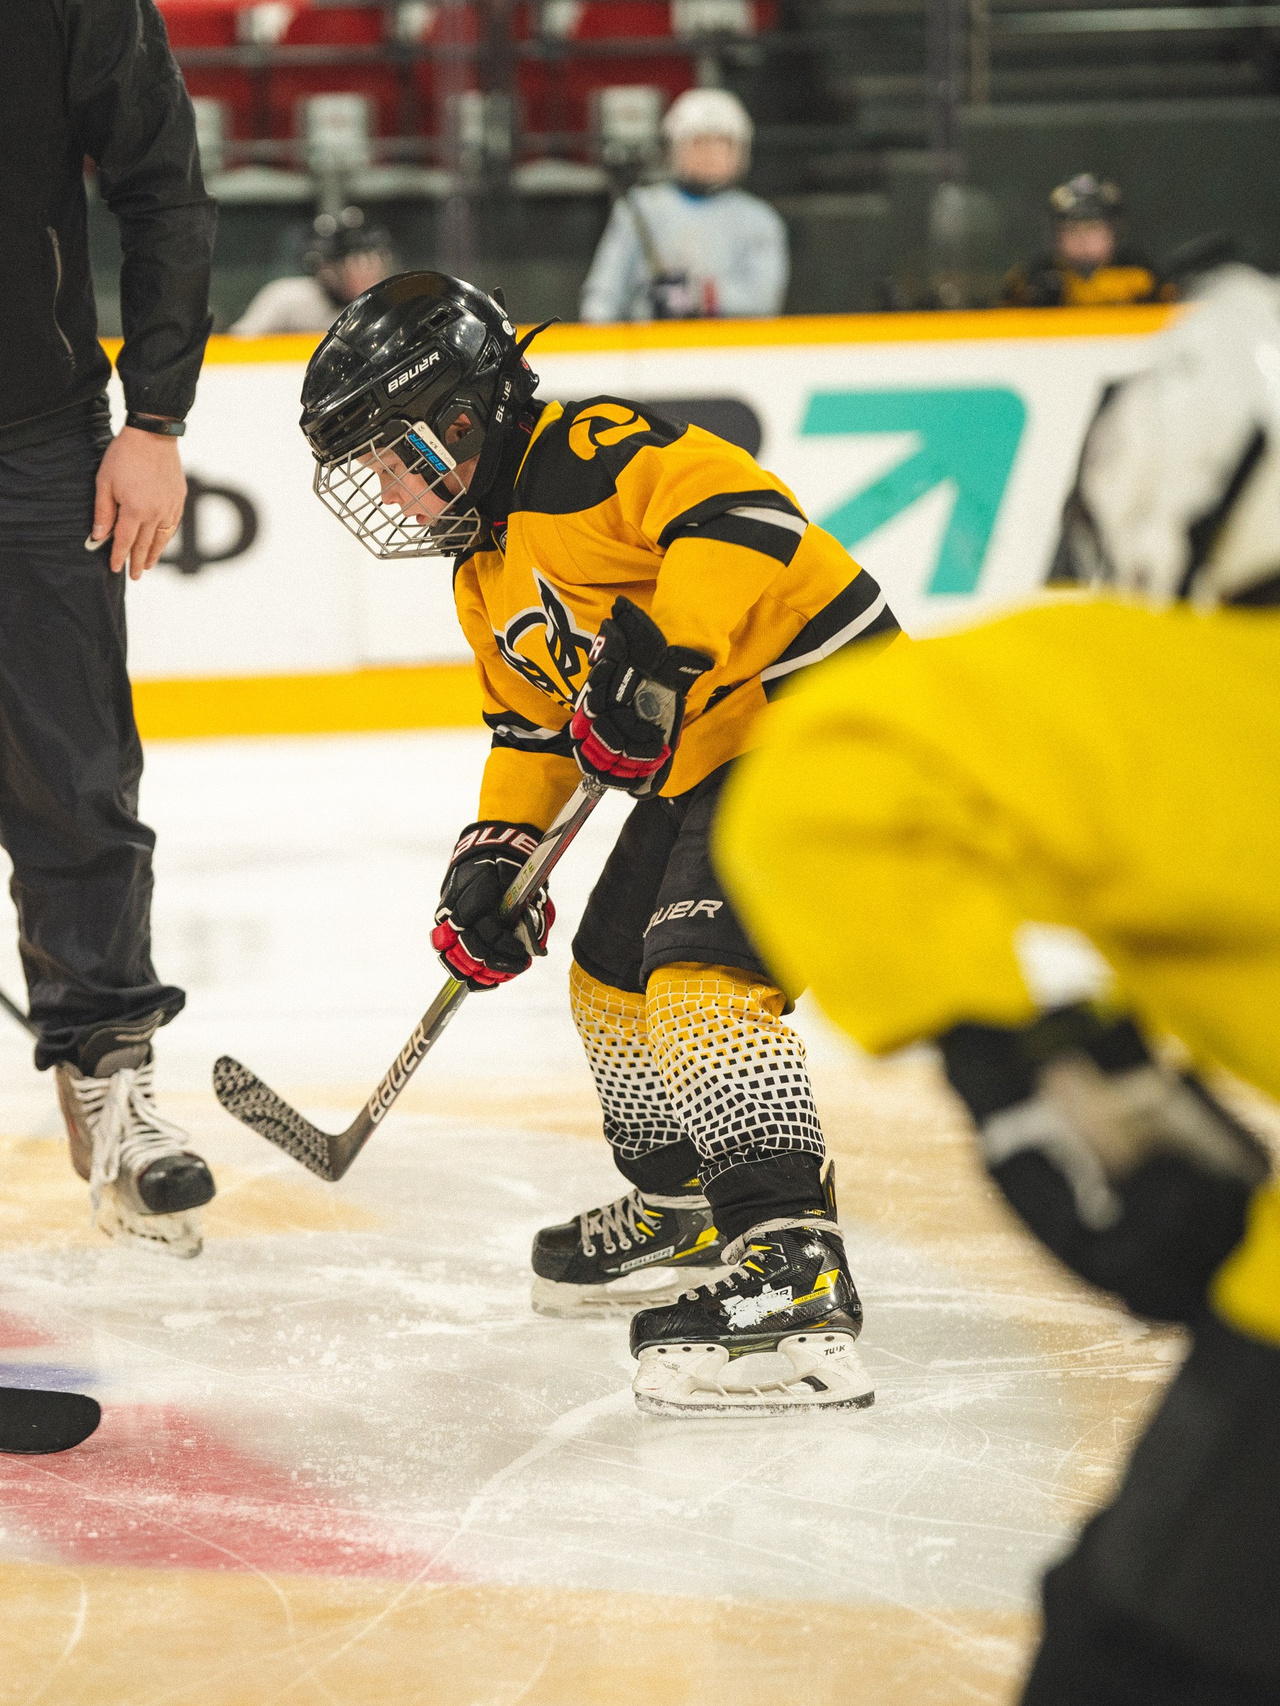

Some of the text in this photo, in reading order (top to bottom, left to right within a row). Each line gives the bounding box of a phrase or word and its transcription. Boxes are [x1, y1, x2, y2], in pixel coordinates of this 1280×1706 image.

[387, 351, 441, 394] BAUER
[407, 433, 448, 472] BAUER
[368, 1020, 430, 1123] BAUER
